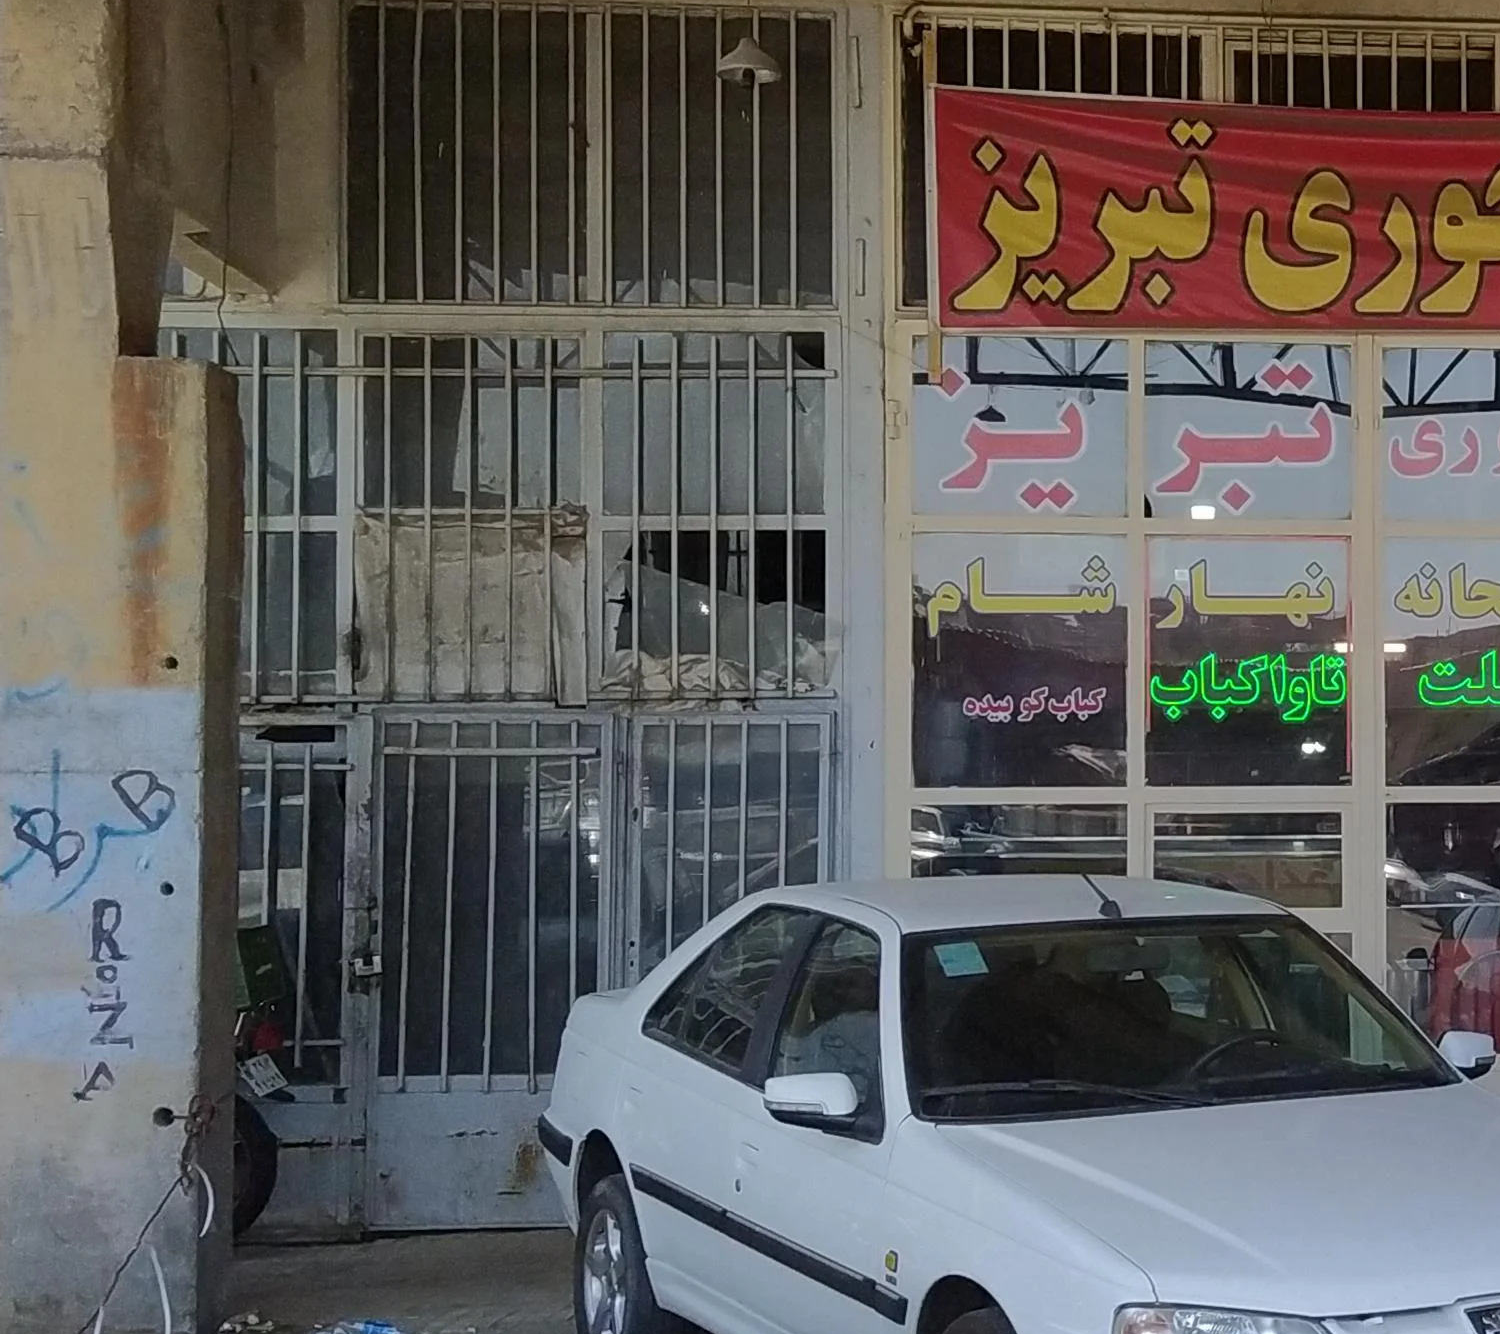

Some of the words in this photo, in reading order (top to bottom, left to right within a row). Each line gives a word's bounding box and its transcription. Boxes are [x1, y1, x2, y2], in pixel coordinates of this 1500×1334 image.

[948, 115, 1215, 315] تبریز
[927, 555, 1117, 638] شام
[1155, 559, 1335, 629] نهار
